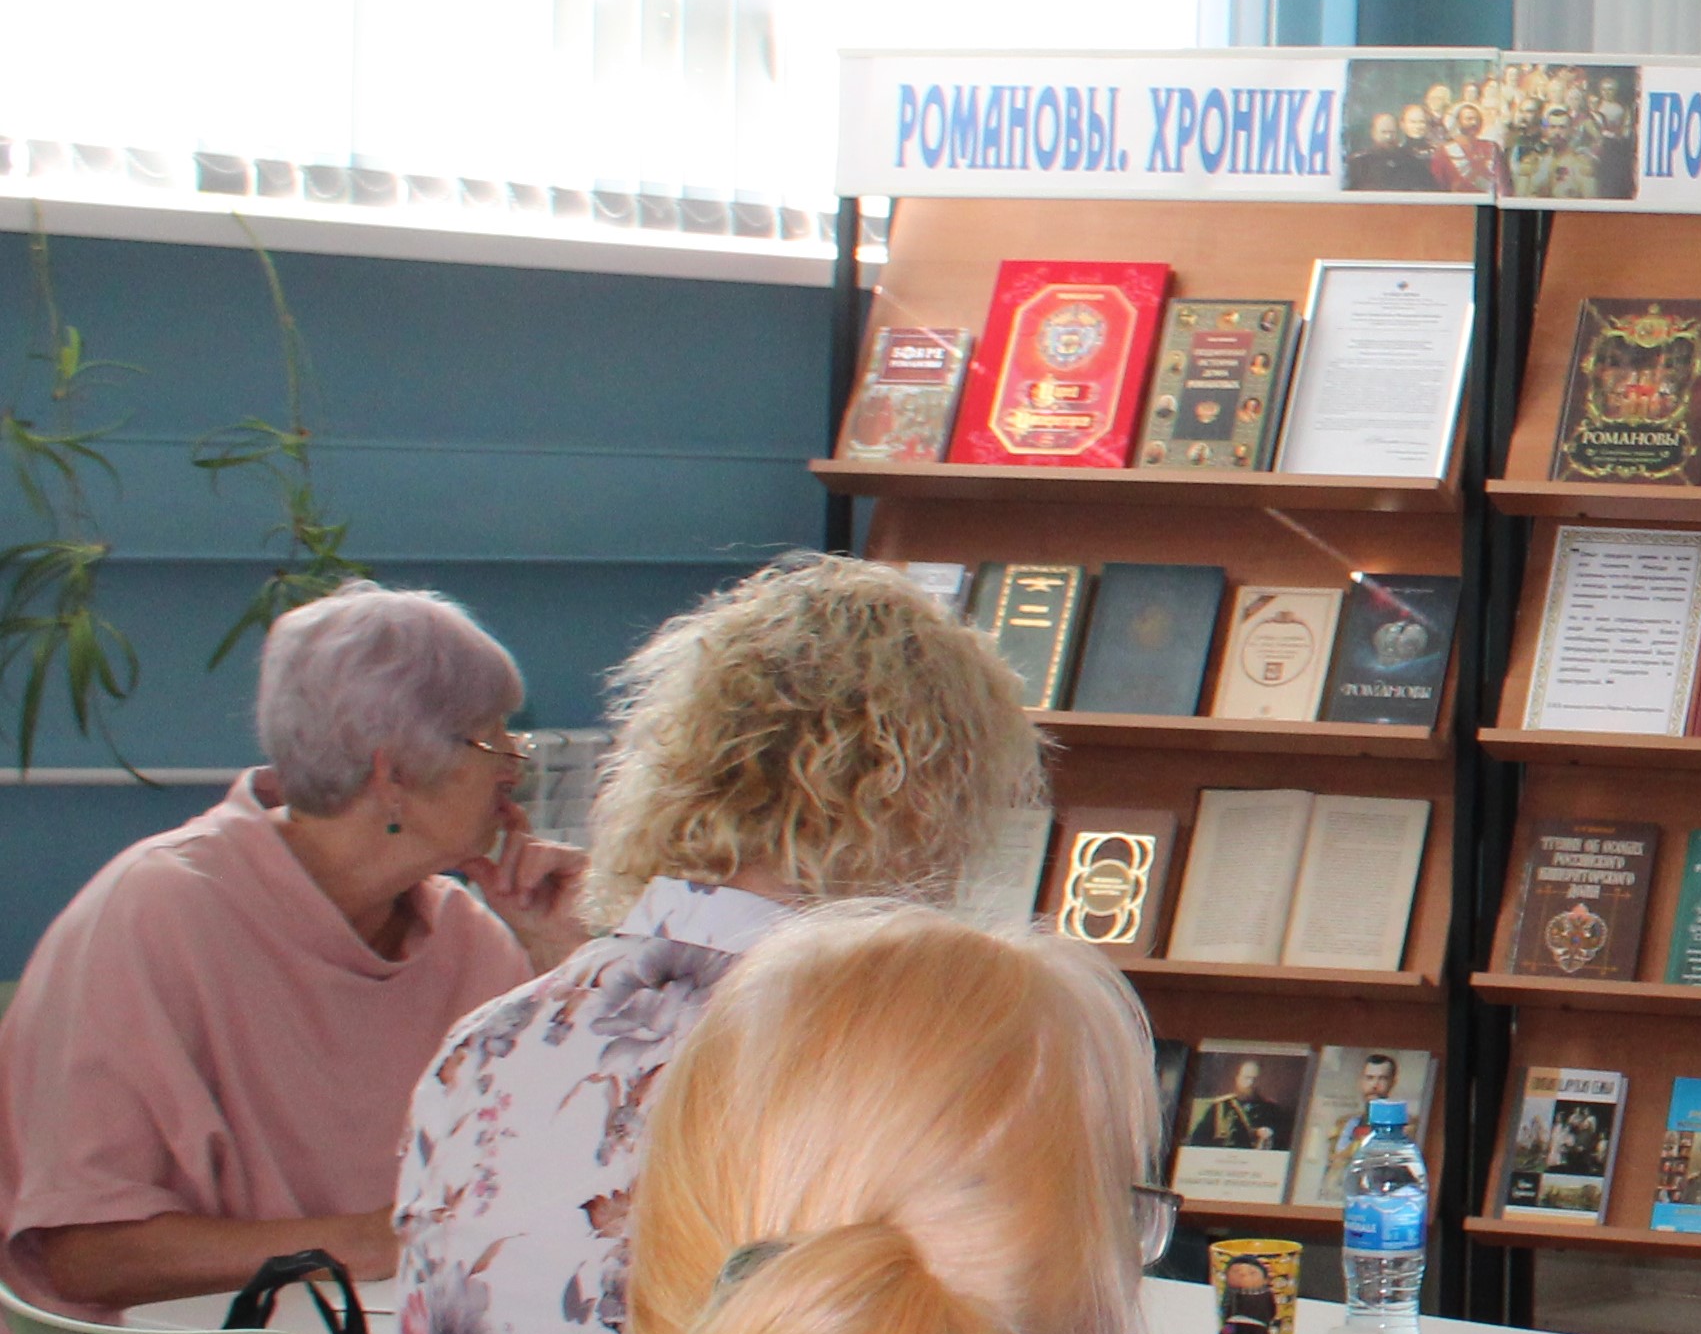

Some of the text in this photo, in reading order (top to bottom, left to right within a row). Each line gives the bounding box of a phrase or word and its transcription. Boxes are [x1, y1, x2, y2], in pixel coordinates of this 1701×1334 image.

[894, 84, 1128, 173] РОМАНОВЫ.
[1145, 86, 1336, 177] ХРОНИКА
[1582, 430, 1681, 447] РОМАНОВЫ
